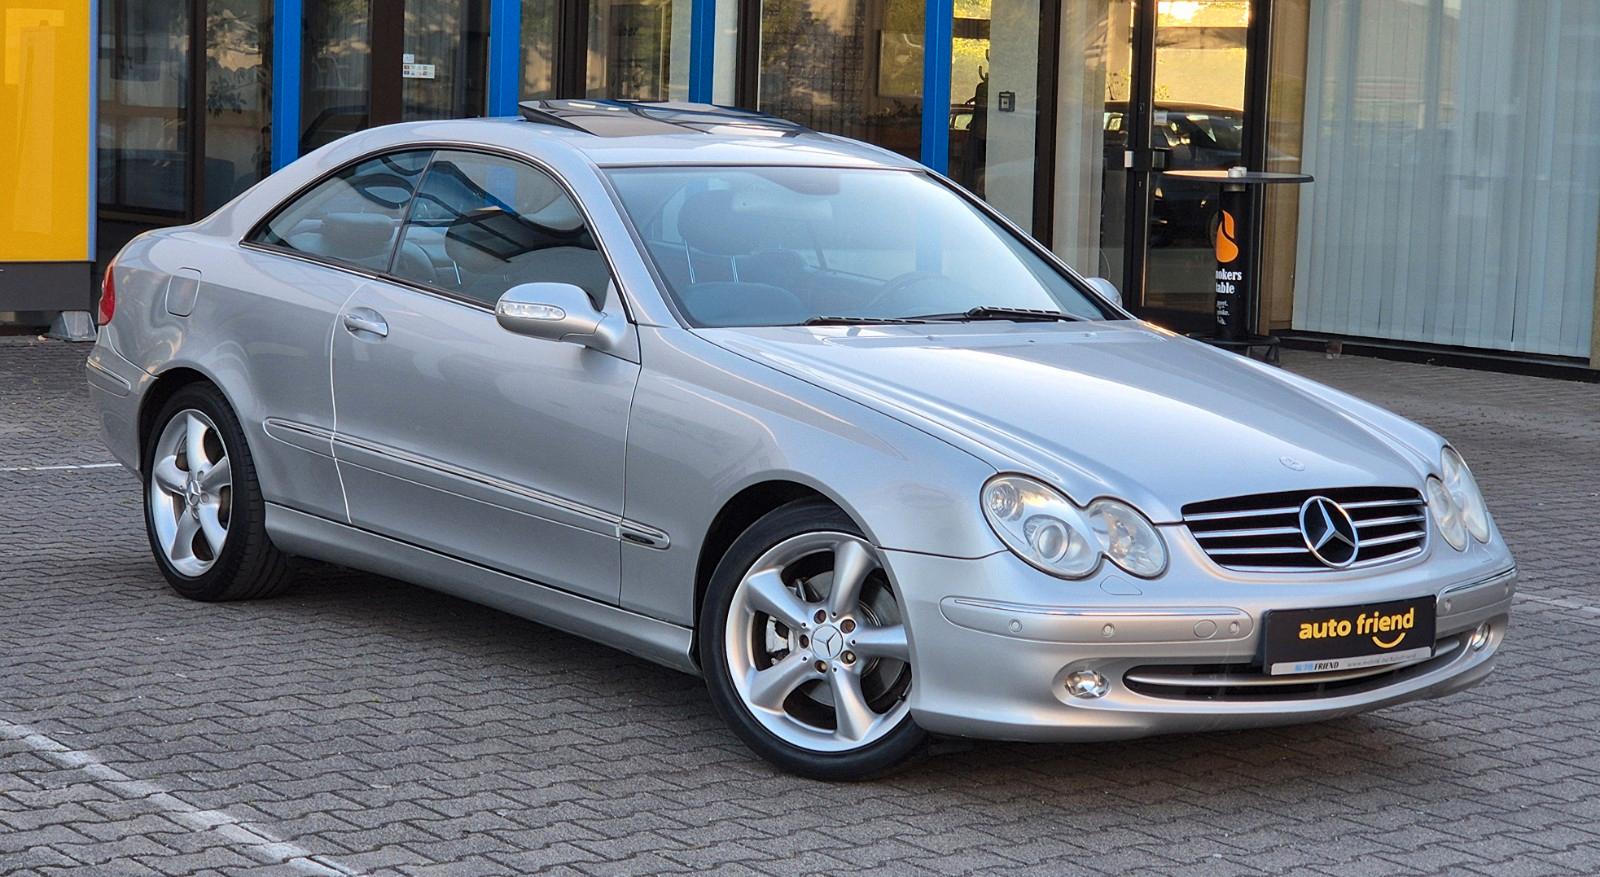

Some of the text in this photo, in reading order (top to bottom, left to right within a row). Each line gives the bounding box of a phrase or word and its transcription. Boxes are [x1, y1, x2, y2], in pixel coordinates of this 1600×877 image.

[1298, 607, 1415, 640] auto friend
[1314, 661, 1340, 670] FRIEND
